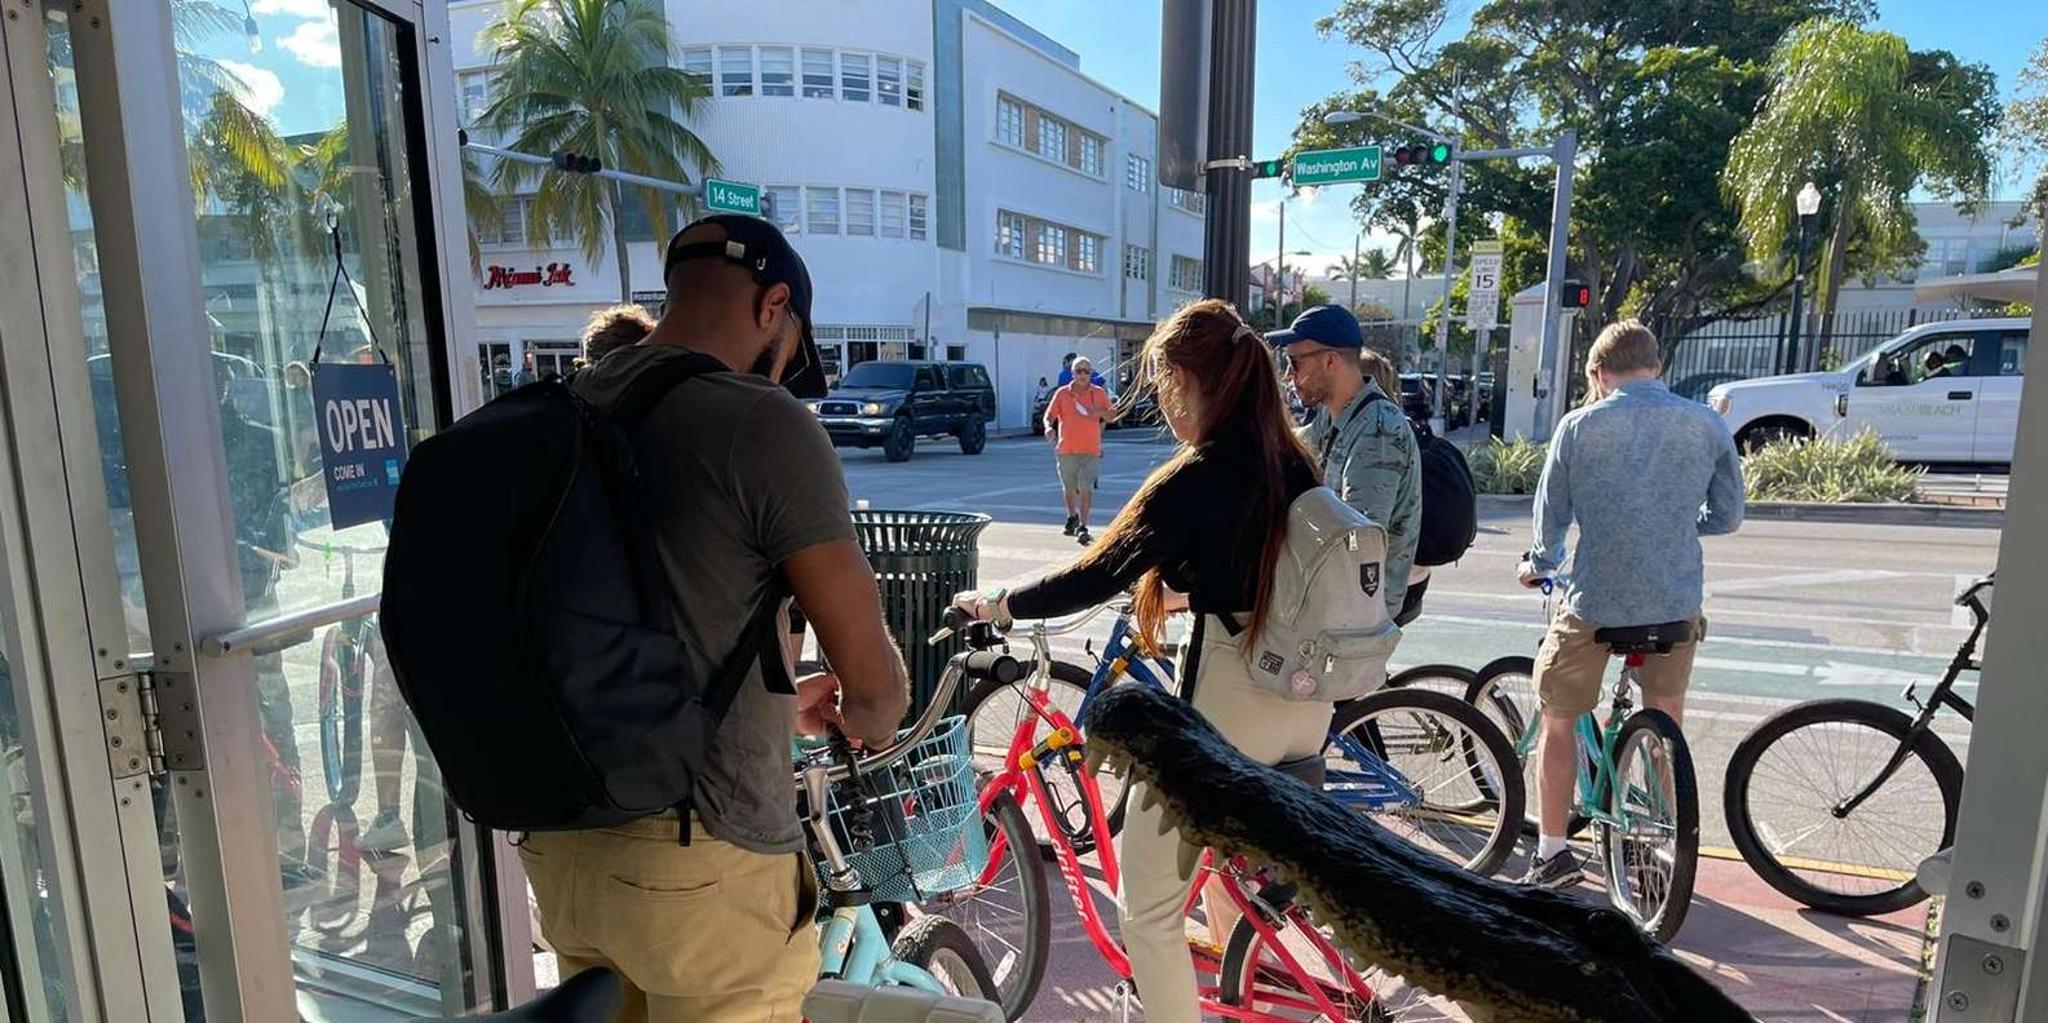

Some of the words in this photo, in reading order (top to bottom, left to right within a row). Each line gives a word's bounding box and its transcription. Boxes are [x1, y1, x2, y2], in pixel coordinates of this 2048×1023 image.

[1297, 160, 1357, 176] Washington
[1361, 158, 1377, 170] Av
[713, 187, 725, 204] 14
[727, 191, 754, 208] Street
[1476, 274, 1494, 288] 15
[326, 399, 395, 453] OPEN
[333, 466, 355, 481] COME
[355, 463, 365, 478] IN
[1051, 838, 1089, 922] drifter
